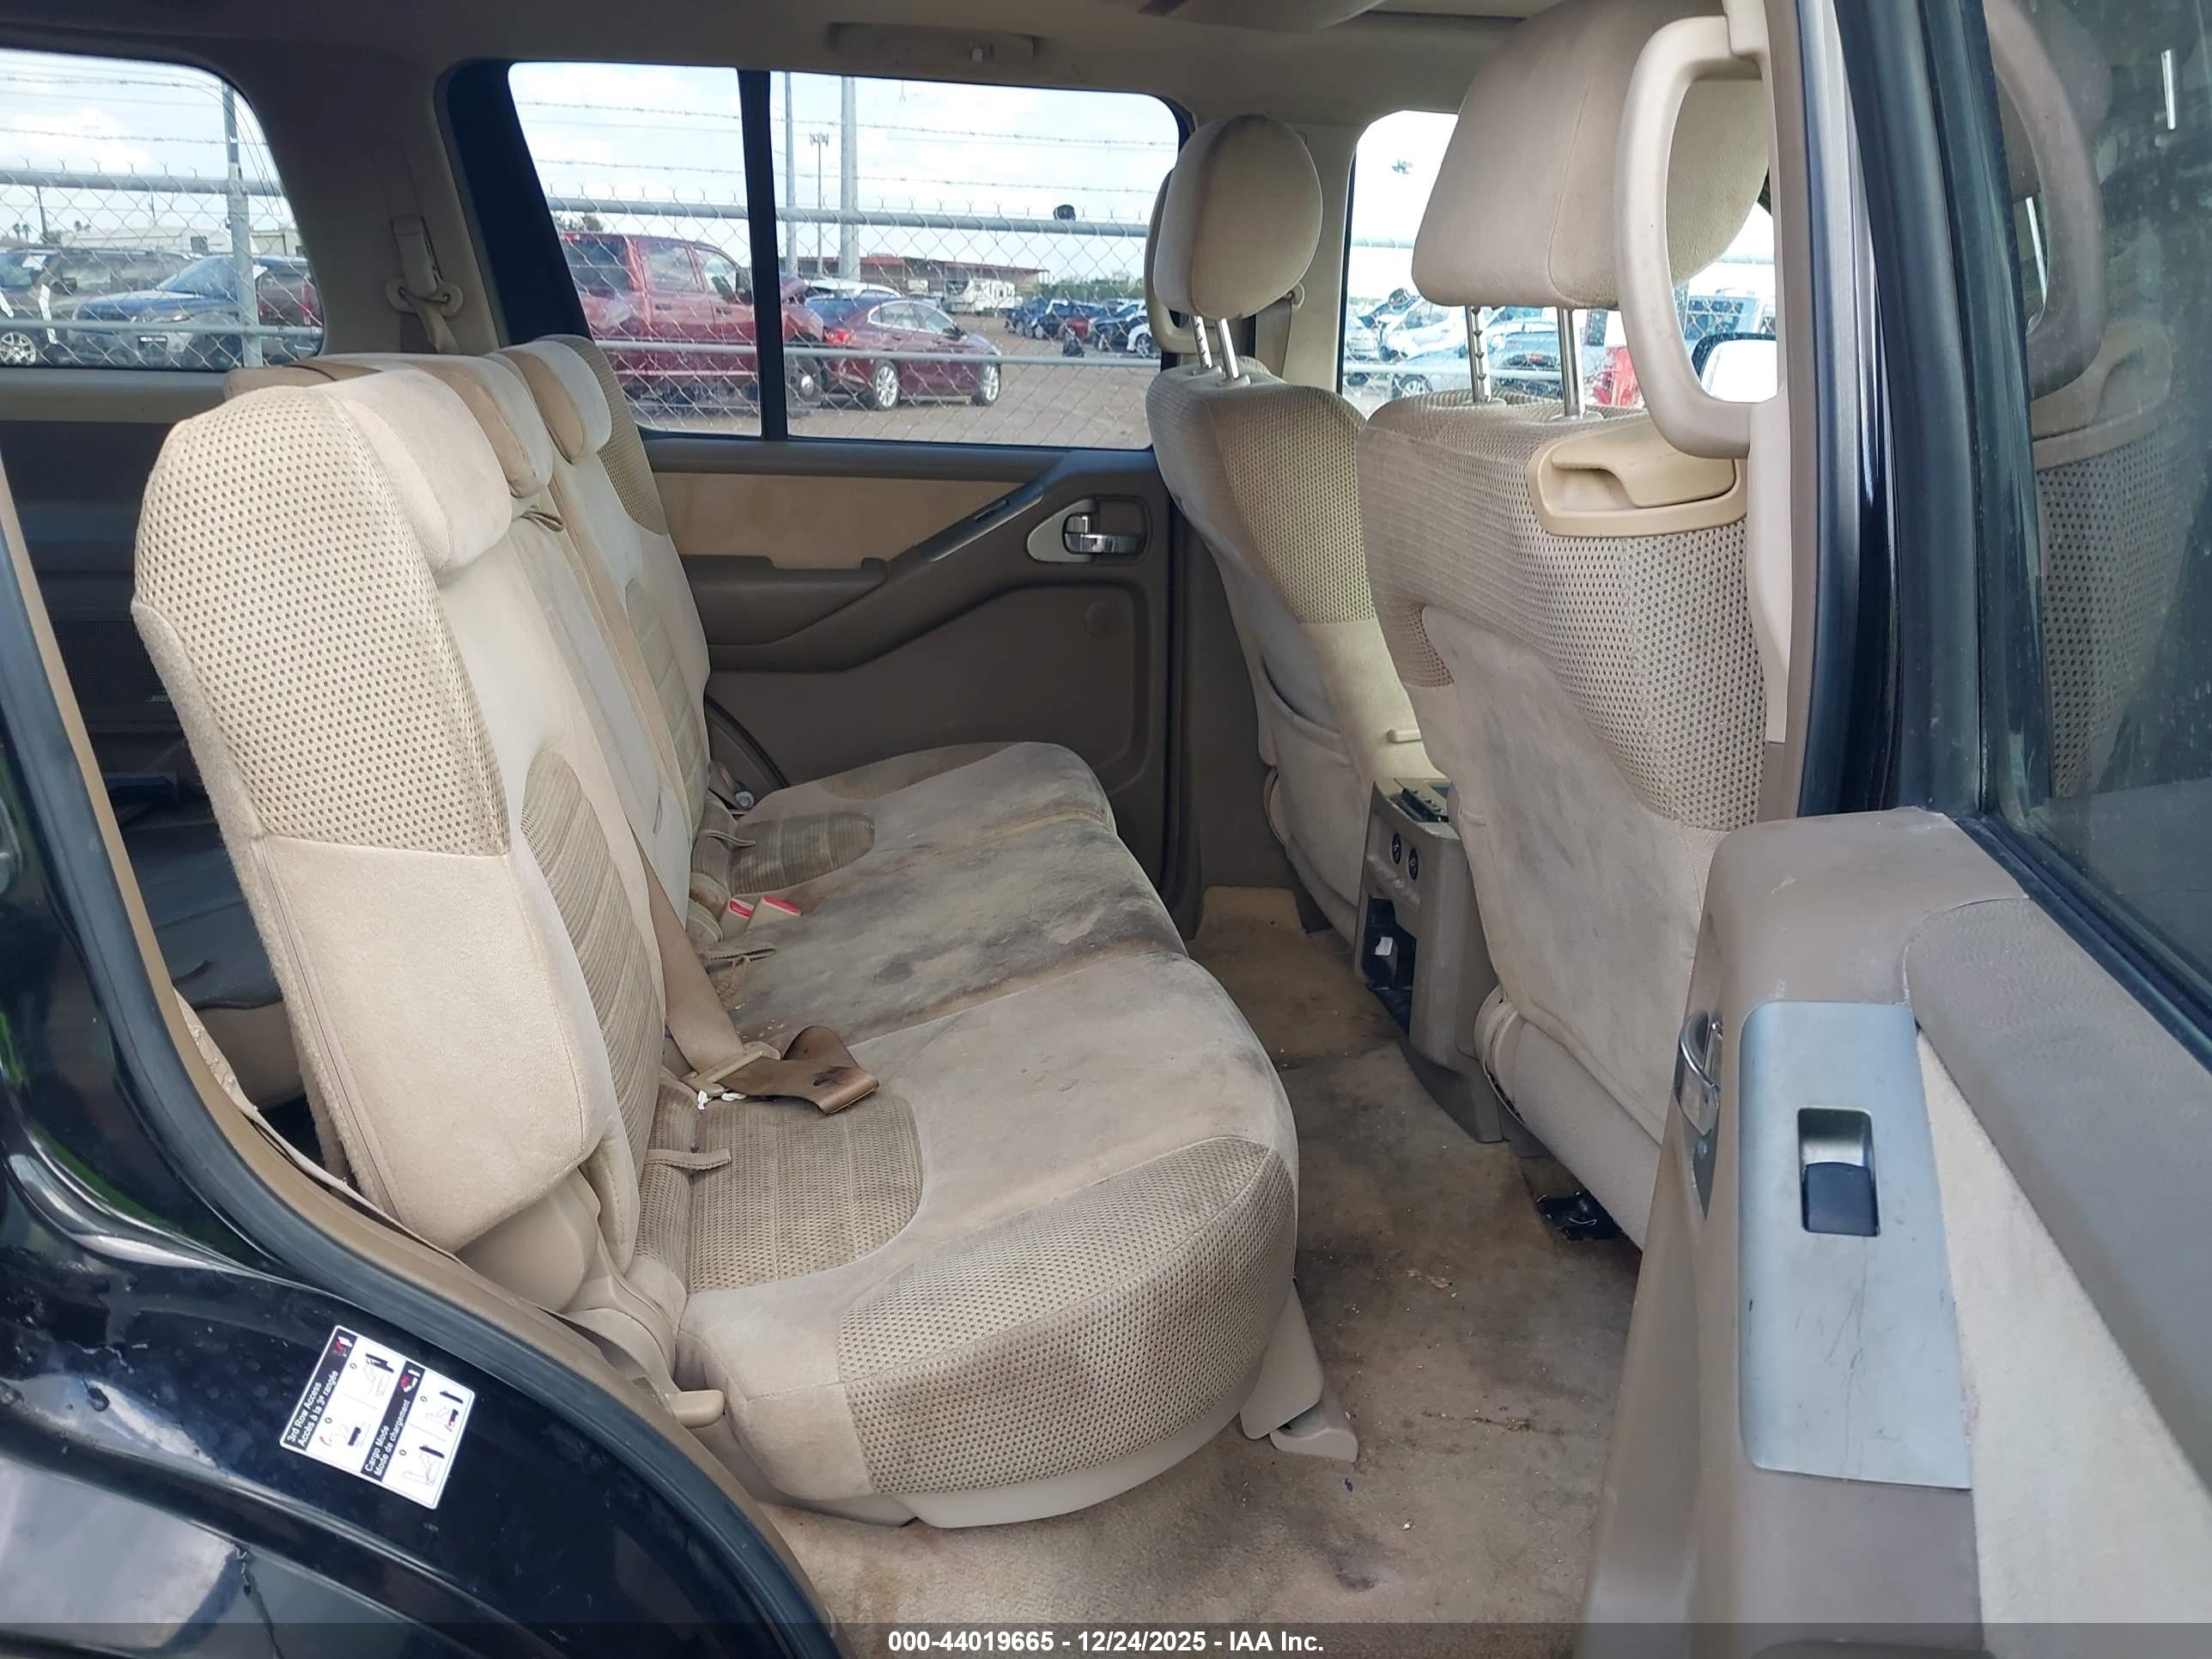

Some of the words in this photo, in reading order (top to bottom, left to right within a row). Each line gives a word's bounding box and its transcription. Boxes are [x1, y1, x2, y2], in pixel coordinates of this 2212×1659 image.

[287, 1427, 300, 1443] 3rd
[294, 1408, 308, 1428] Row
[303, 1382, 322, 1410] Access
[312, 1406, 322, 1414] la
[364, 1448, 380, 1472] Cargo
[375, 1425, 390, 1447] Mode
[374, 1454, 389, 1476] Mode
[384, 1443, 394, 1453] de
[389, 1399, 410, 1442] chargement
